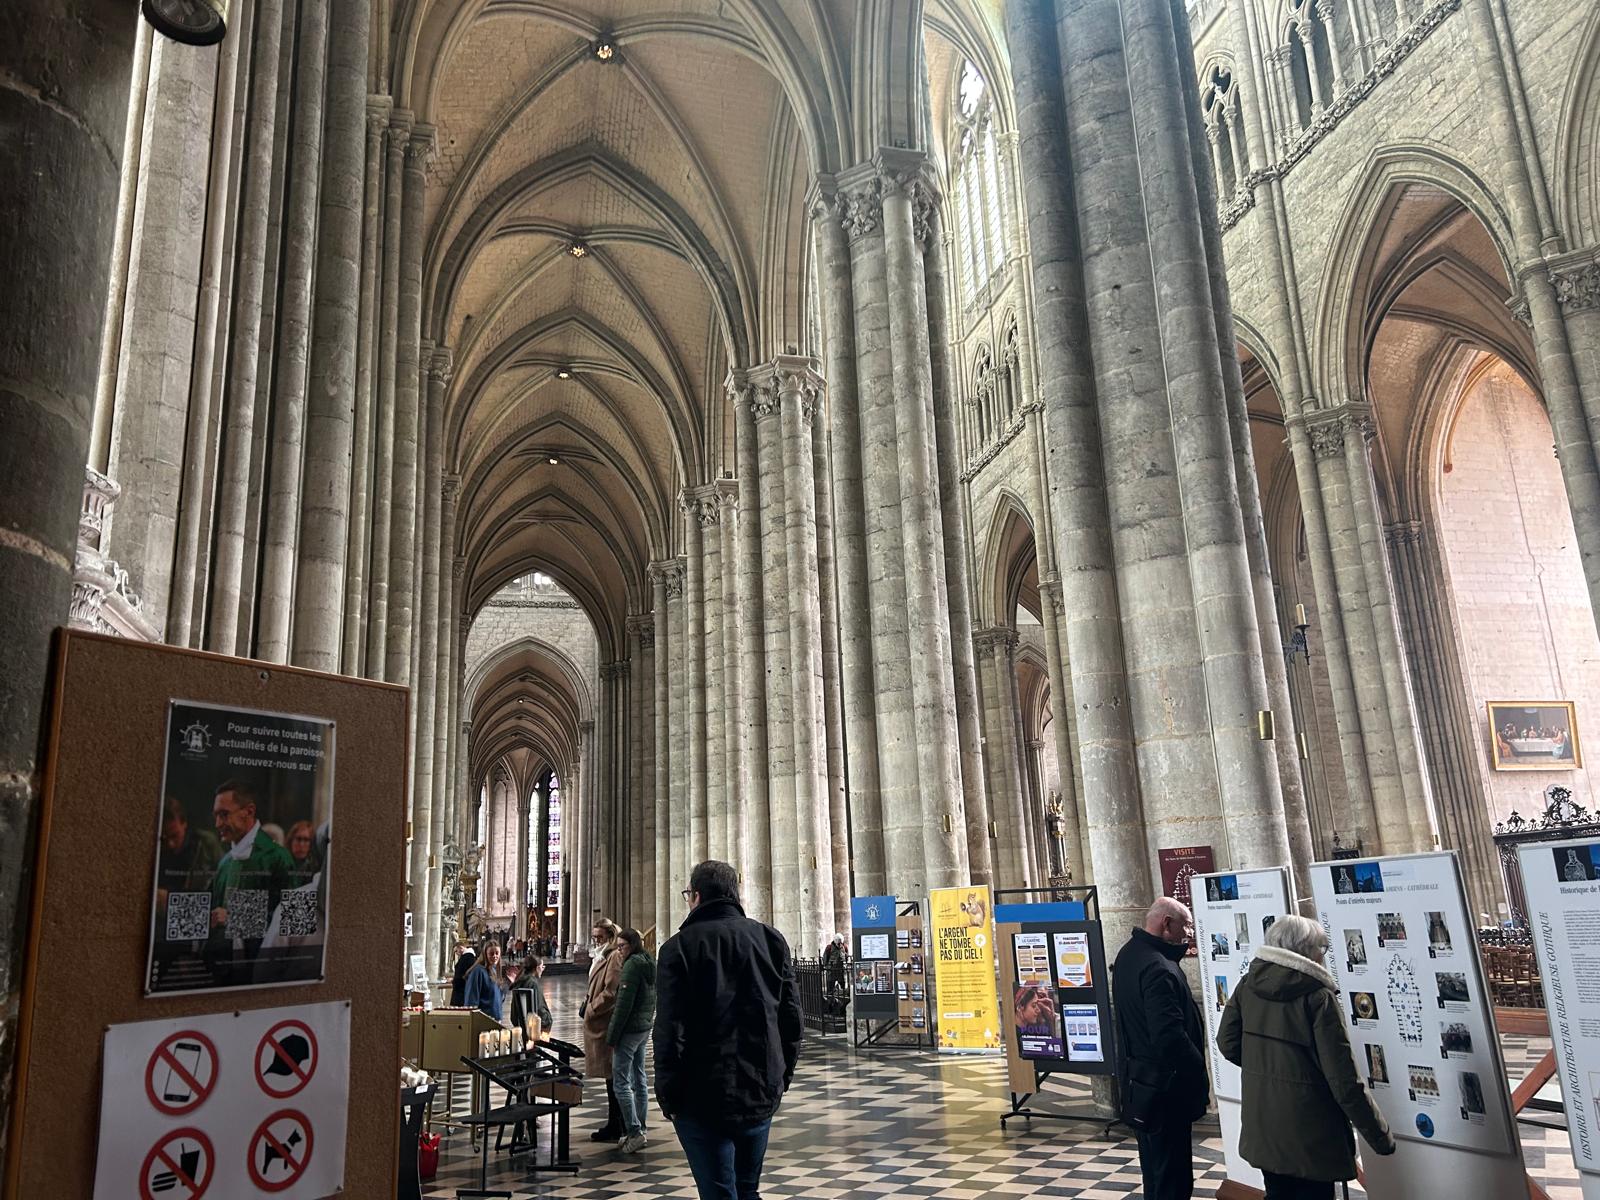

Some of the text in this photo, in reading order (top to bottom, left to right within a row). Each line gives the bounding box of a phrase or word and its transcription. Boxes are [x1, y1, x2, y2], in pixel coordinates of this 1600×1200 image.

[228, 722, 321, 742] Pour suivre toutes les
[219, 738, 265, 751] actualités
[267, 742, 278, 752] de
[280, 743, 288, 753] la
[229, 756, 297, 769] retrouvez-nous
[299, 762, 312, 771] sur
[1174, 848, 1196, 856] VISITE
[1560, 885, 1597, 895] Historique de
[939, 927, 968, 938] L'ARGENT
[940, 938, 971, 949] NE TOMBE
[940, 949, 952, 960] PAS
[954, 949, 963, 960] DU
[964, 948, 979, 960] CIEL
[1539, 911, 1592, 1161] HISTOIRE ET ARCHITECTURE RELIGIEUSE GOTHIQUE
